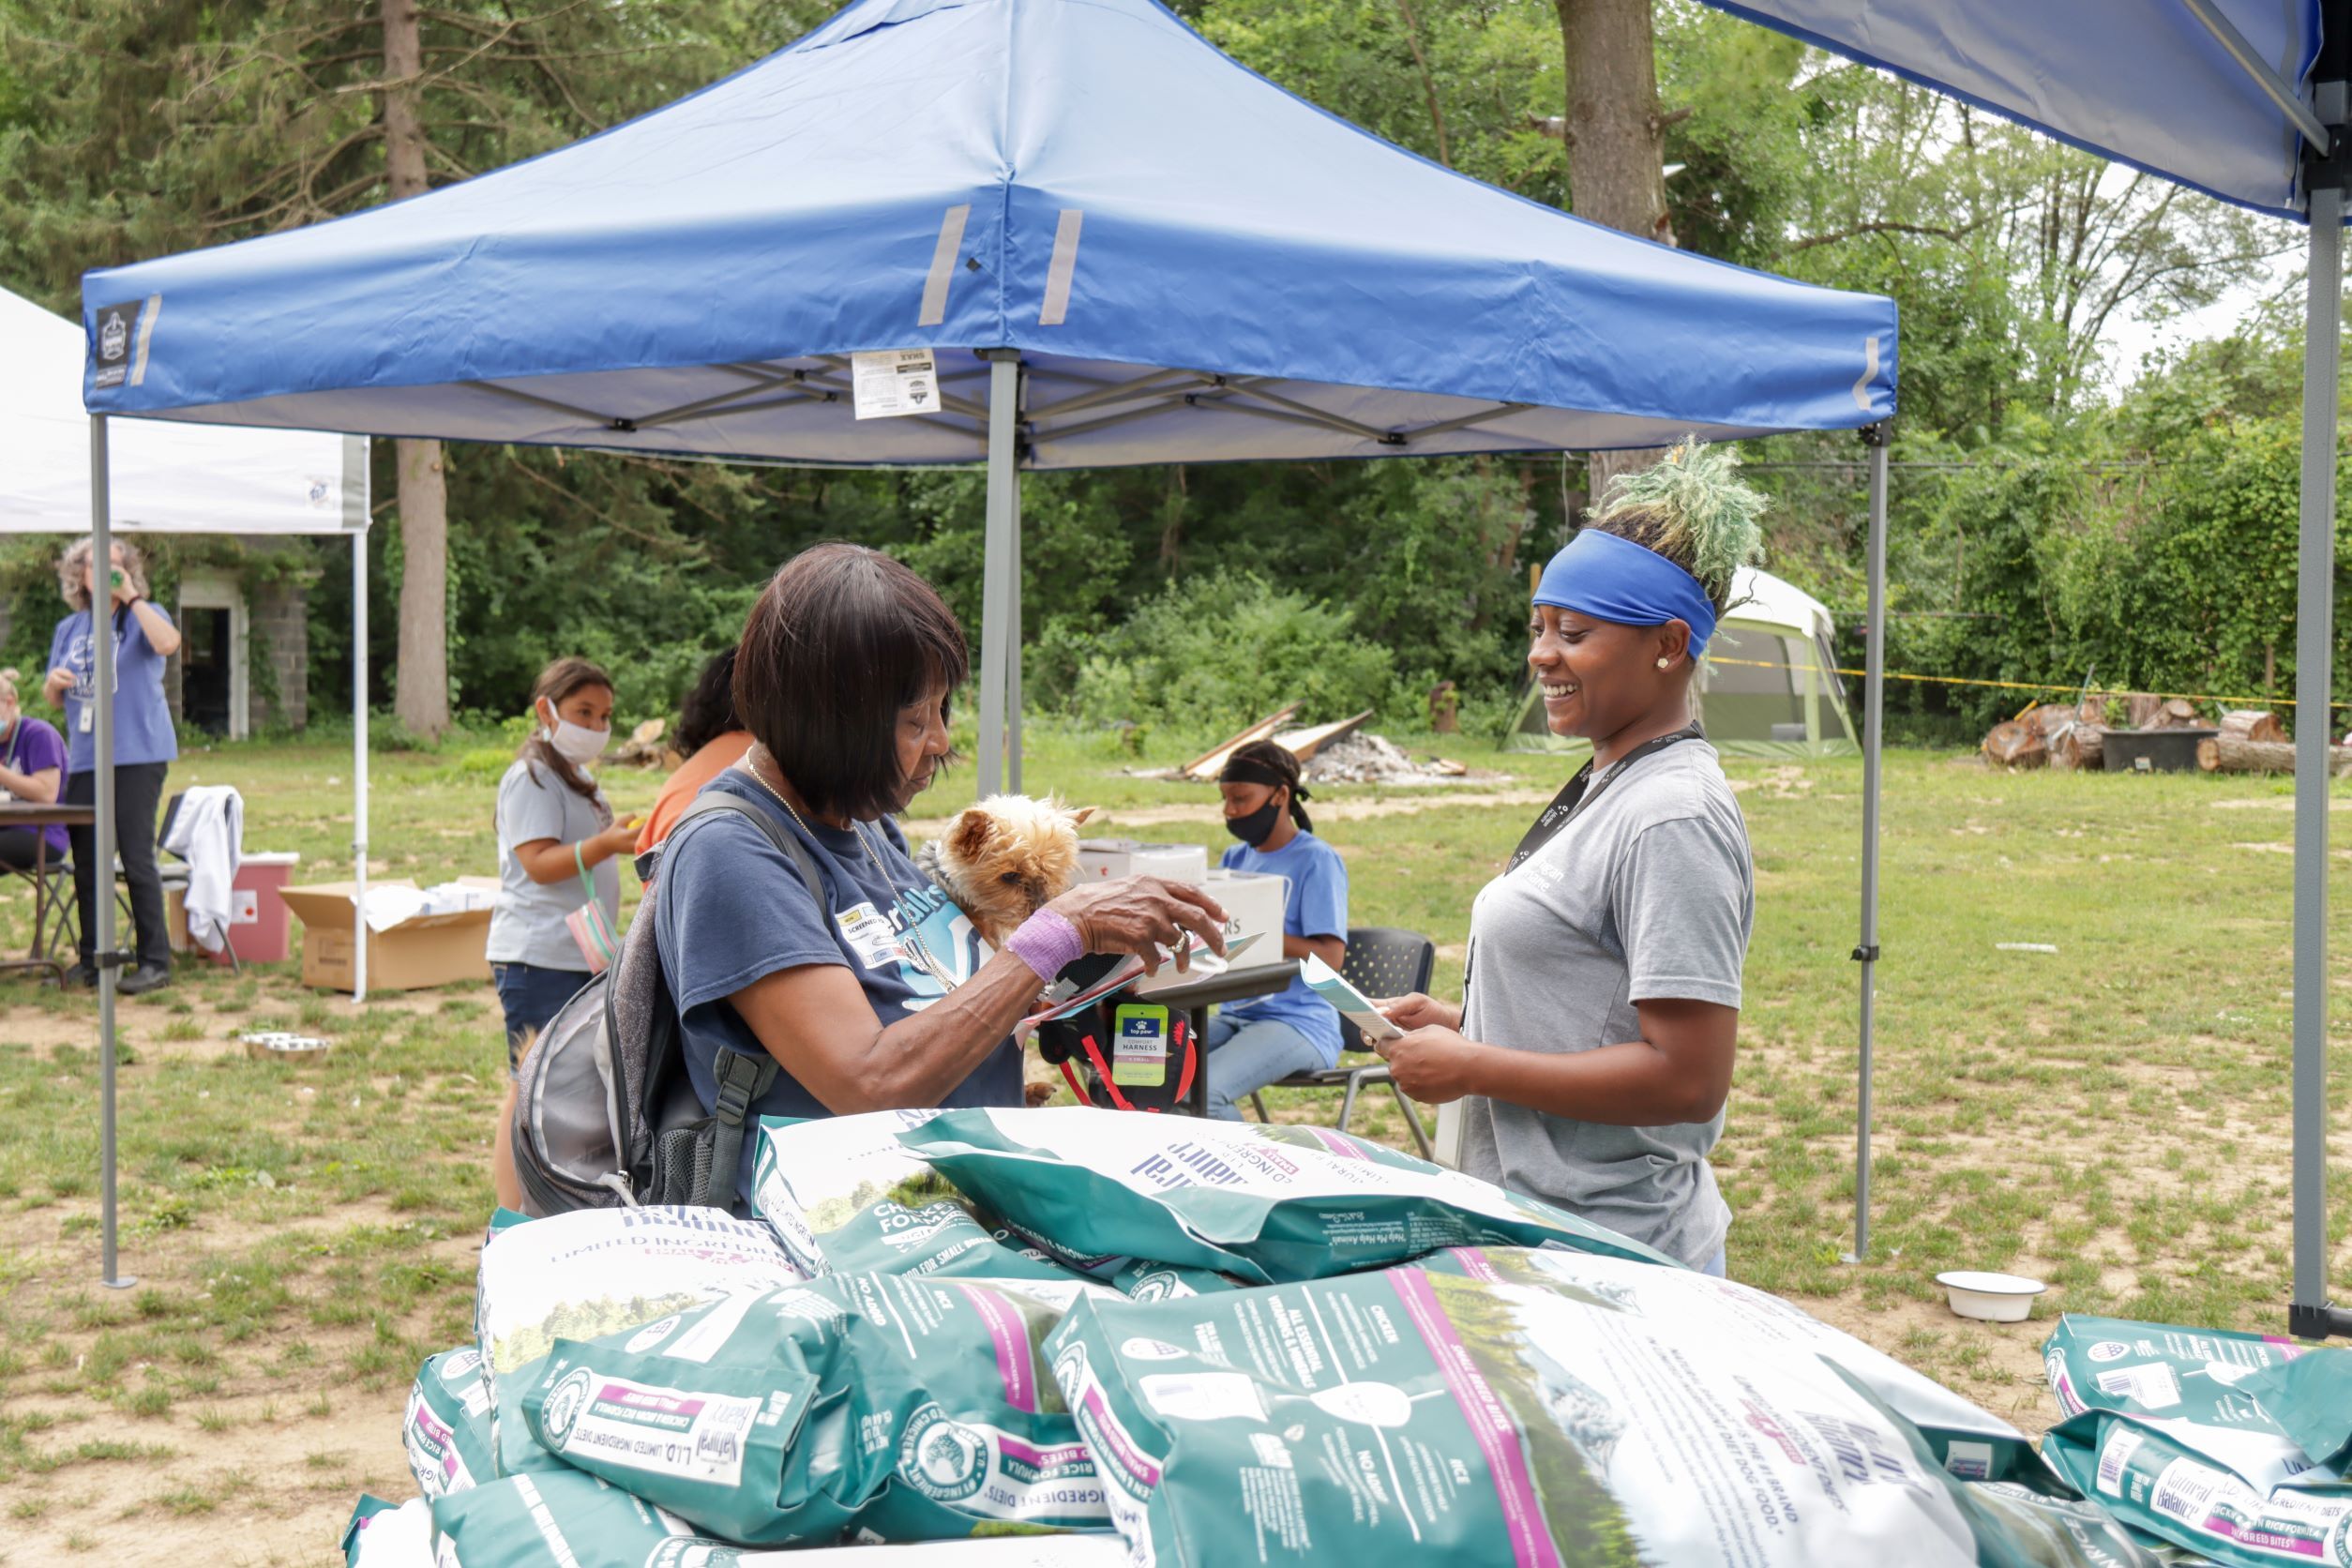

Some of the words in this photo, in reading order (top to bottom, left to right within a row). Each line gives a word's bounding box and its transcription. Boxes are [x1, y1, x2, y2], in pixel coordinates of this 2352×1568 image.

[1358, 1232, 1375, 1244] Help
[1376, 1232, 1388, 1244] Me
[917, 1256, 940, 1275] FOR
[934, 1242, 967, 1265] SMALL
[853, 1274, 872, 1296] NO
[859, 1290, 890, 1329] ADDED
[931, 1285, 955, 1314] RICE
[1265, 1293, 1295, 1340] VITAMINS
[1286, 1305, 1304, 1327] ALL
[1369, 1301, 1399, 1347] CHICKEN
[1293, 1323, 1325, 1374] ESSENTIAL
[1449, 1338, 1477, 1376] SMALL
[1466, 1368, 1496, 1408] BREED
[422, 1436, 443, 1456] RICE
[591, 1430, 633, 1453] INGREDIENT
[632, 1439, 663, 1458] LIMITED
[662, 1441, 692, 1466] L.I.D.
[695, 1427, 739, 1462] Natural
[1743, 1438, 1766, 1466] THE
[1005, 1458, 1060, 1482] FORMULA
[1059, 1459, 1093, 1478] RICE
[1354, 1447, 1377, 1472] NO
[1717, 1427, 1743, 1461] DIET
[1734, 1455, 1760, 1491] DOG
[1756, 1460, 1773, 1480] #1
[906, 1467, 963, 1500] INGREDIENT
[1764, 1474, 1802, 1527] BRAND
[2153, 1485, 2202, 1522] Balance
[2319, 1502, 2342, 1519] DIETS
[2241, 1529, 2270, 1545] BREED
[2264, 1518, 2284, 1531] RICE
